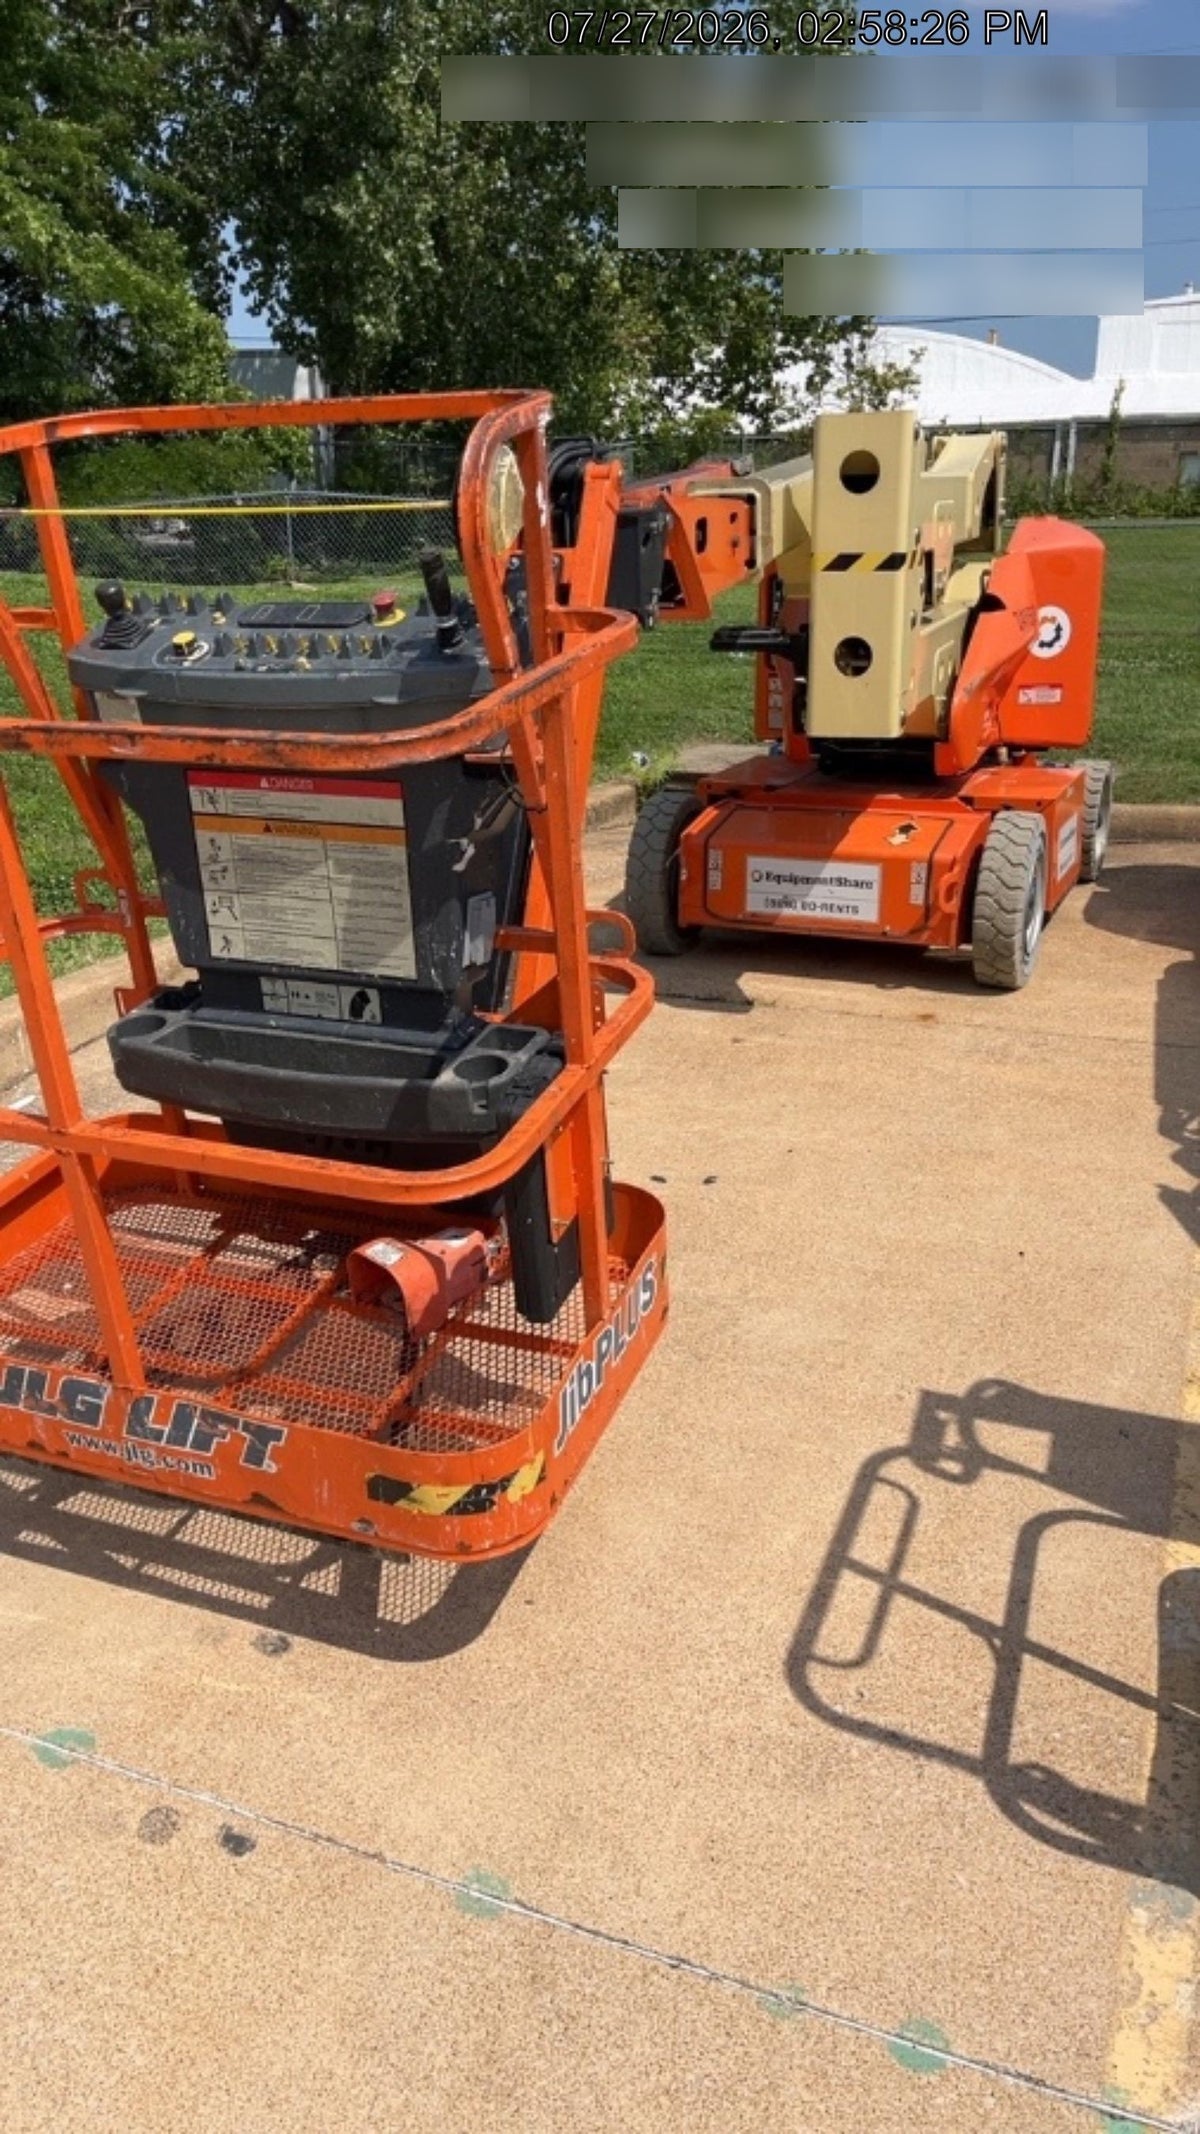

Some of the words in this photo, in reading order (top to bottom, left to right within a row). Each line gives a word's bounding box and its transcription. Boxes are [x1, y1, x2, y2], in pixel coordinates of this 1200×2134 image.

[765, 871, 874, 889] EquipmentShare
[554, 1258, 657, 1457] JibPLUS
[0, 1364, 110, 1430] JLG
[123, 1394, 288, 1469] LIFT
[64, 1430, 215, 1480] www.jlg.com
